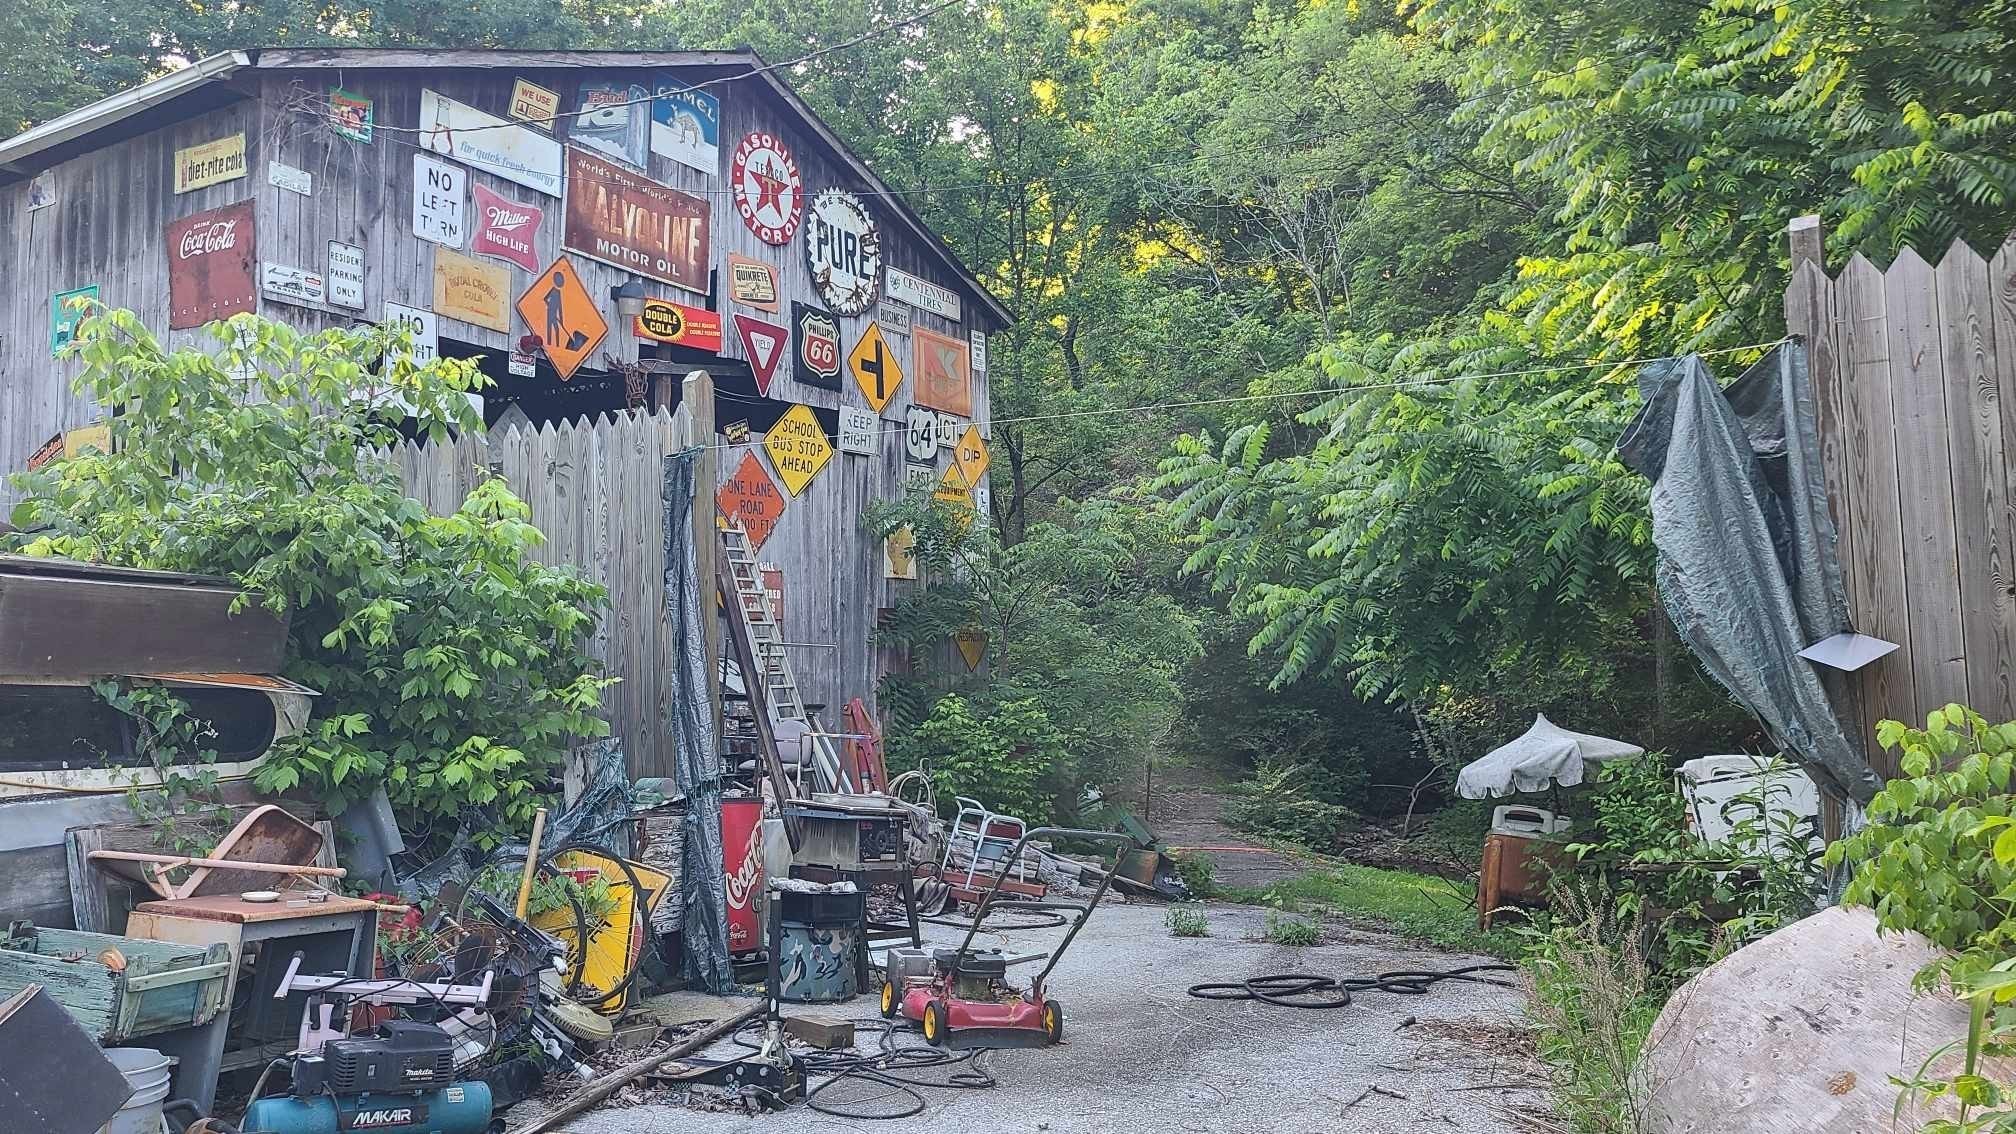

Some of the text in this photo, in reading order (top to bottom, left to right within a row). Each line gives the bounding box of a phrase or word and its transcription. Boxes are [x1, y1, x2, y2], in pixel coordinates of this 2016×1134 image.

[521, 87, 551, 106] WE USE
[225, 150, 243, 173] cola
[459, 141, 556, 187] for quick fresh energy
[735, 134, 801, 189] GASOLINE
[428, 167, 452, 192] NO
[755, 162, 784, 182] TEXACO
[486, 206, 532, 231] Miller
[734, 184, 802, 243] MOTOR OIL
[420, 214, 458, 238] TRN
[180, 219, 237, 259] Coca-Cola
[485, 229, 529, 254] HIGH LIFE
[330, 250, 363, 267] RESIDENT
[596, 238, 681, 277] MOTOR OIL
[816, 218, 872, 281] PURE
[330, 267, 363, 283] PARKING
[735, 269, 769, 282] QUIKRETE
[336, 286, 356, 297] ONLY
[902, 276, 957, 305] CENTENNIAL
[919, 294, 943, 311] TIRES
[645, 309, 678, 324] DOUBLE
[880, 307, 908, 328] BUSINESS
[649, 321, 673, 335] COLA
[808, 323, 834, 340] PHILLIPS
[753, 337, 771, 350] YIELD
[810, 340, 833, 363] 66
[782, 418, 817, 439] SCHOOL
[848, 413, 873, 430] KEEP
[936, 417, 957, 442] JCT
[843, 432, 872, 449] RIGHT
[910, 418, 932, 449] 64
[772, 435, 824, 458] BUS STOP
[963, 447, 981, 464] DIP
[781, 455, 813, 474] AHEAD
[910, 469, 929, 484] EAST
[727, 479, 773, 498] ONE LANE
[740, 499, 764, 516] ROAD
[760, 519, 770, 531] FT
[353, 1108, 412, 1125] MAKAIR
